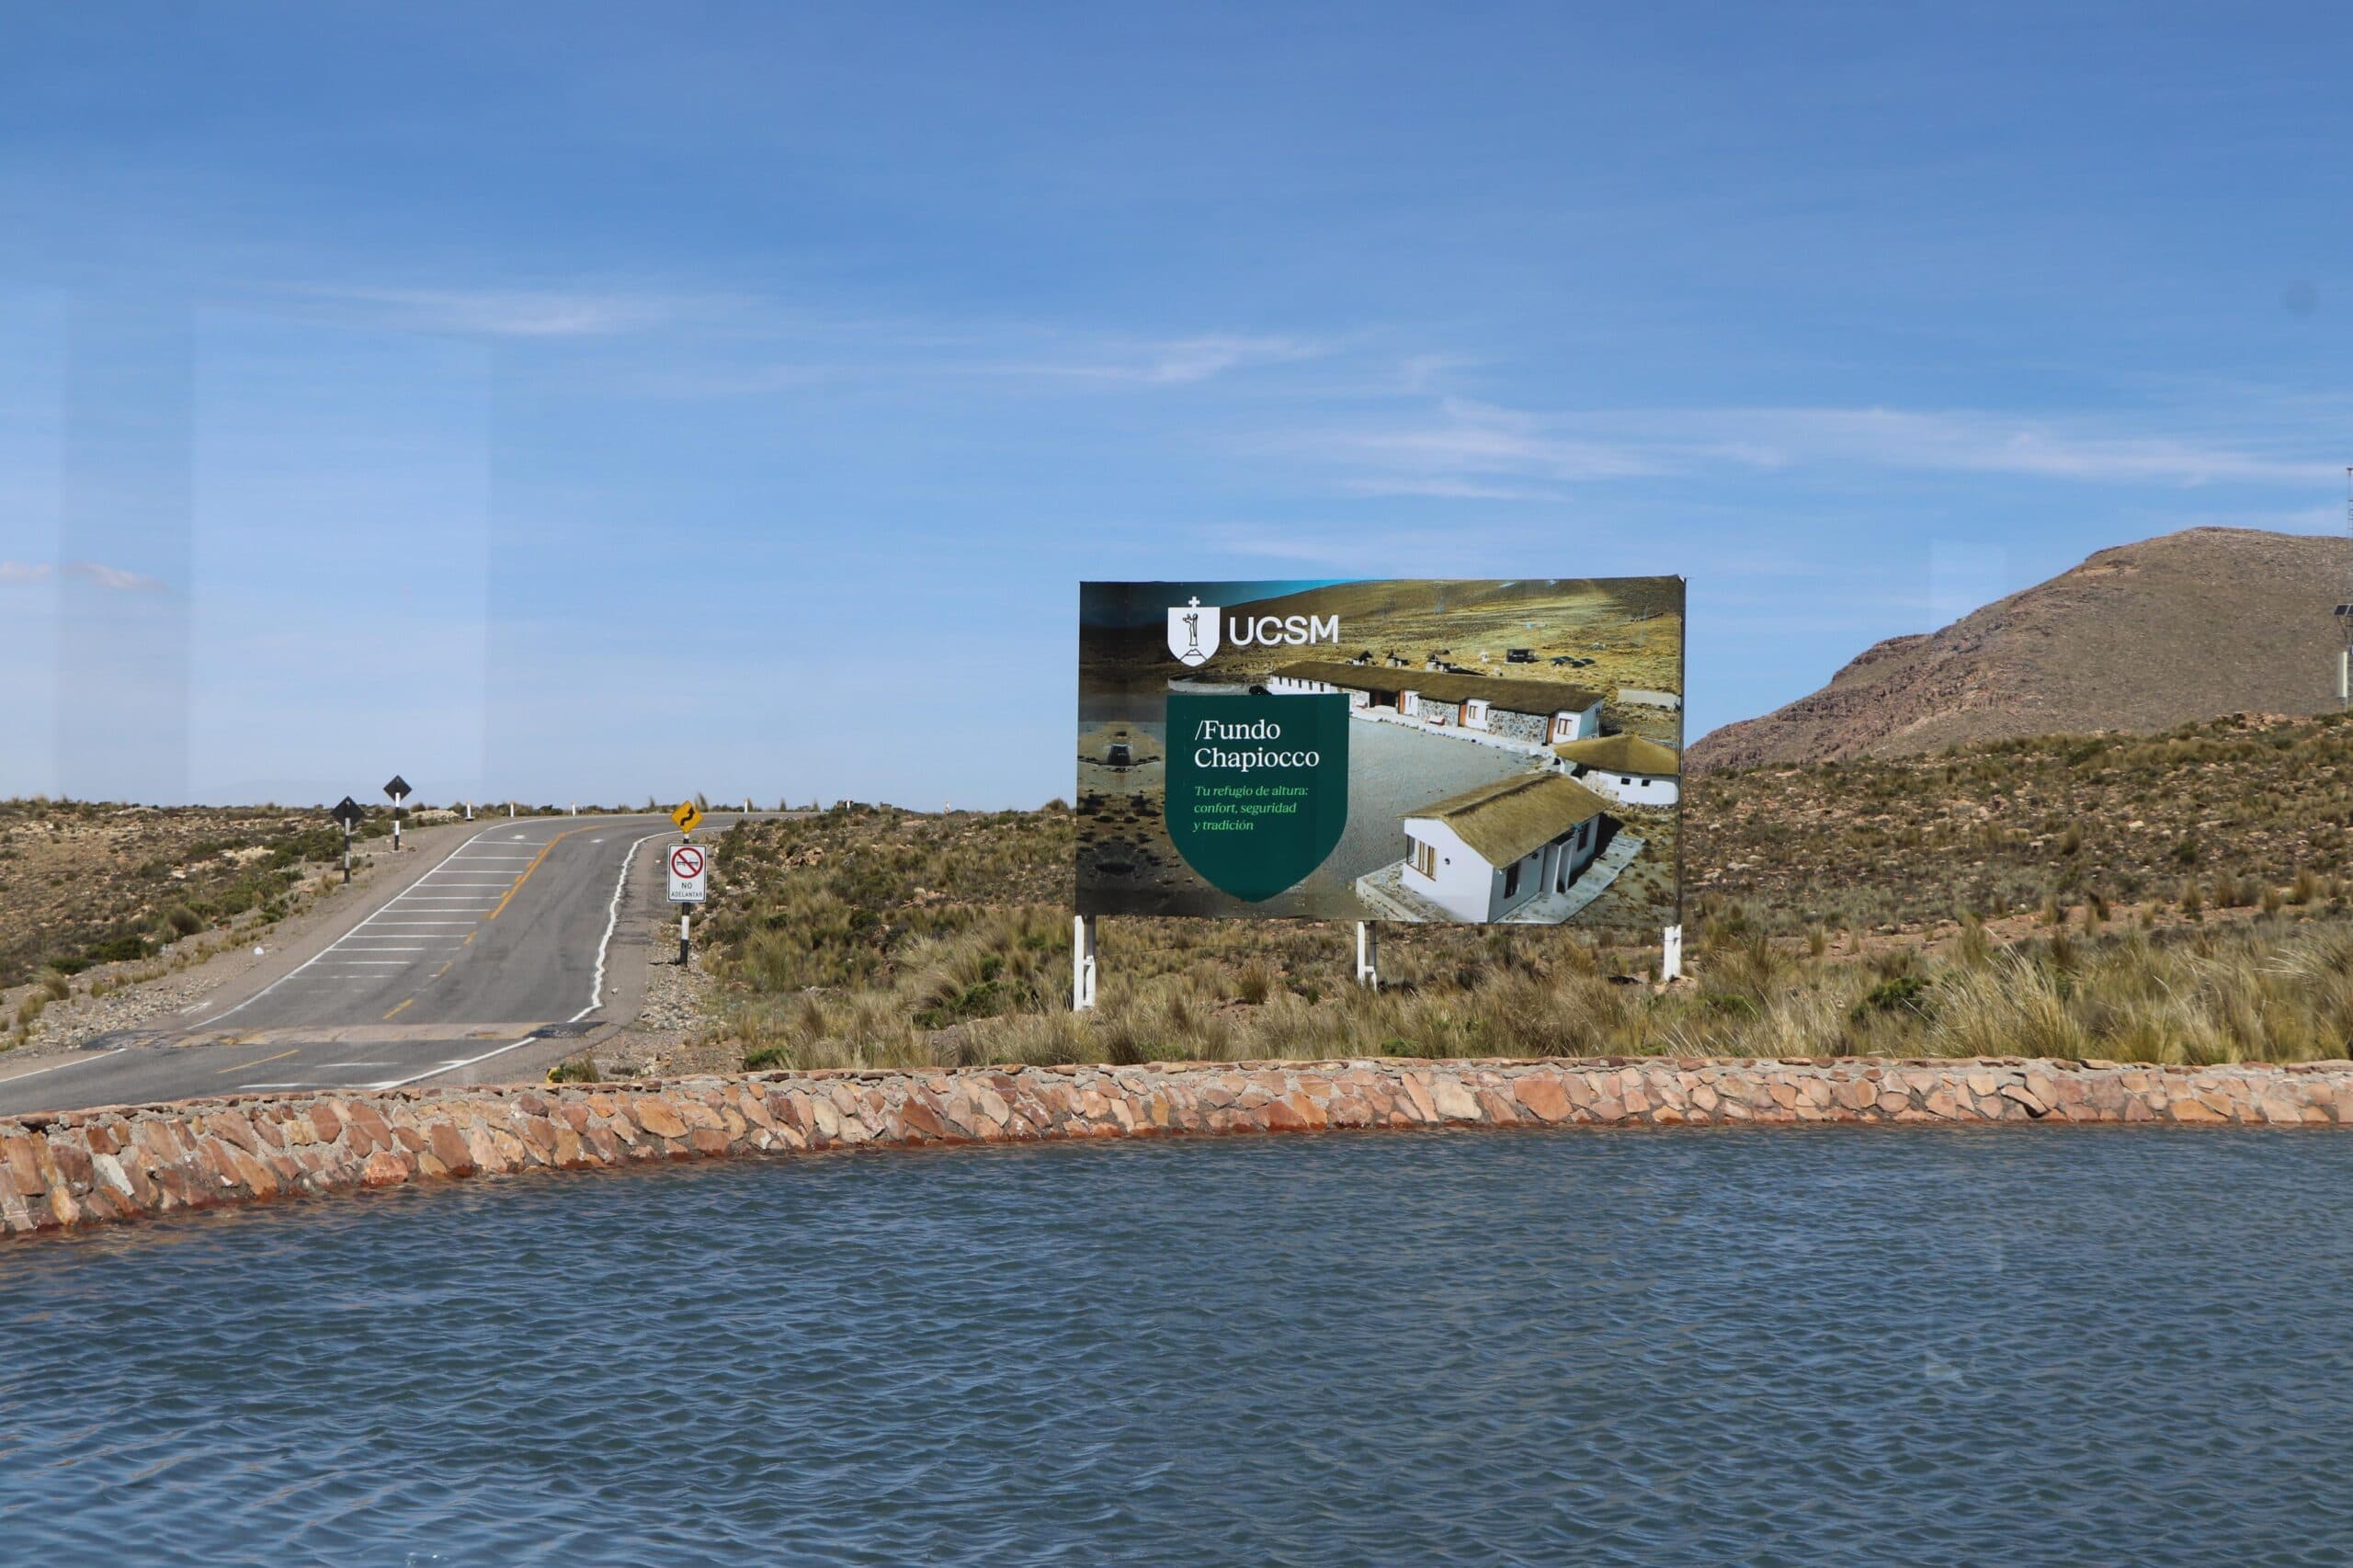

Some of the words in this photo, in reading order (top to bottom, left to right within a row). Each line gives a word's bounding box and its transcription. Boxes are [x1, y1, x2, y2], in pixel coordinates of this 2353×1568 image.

[1229, 615, 1339, 646] UCSM
[1194, 747, 1320, 772] Chapiocco
[1195, 786, 1211, 797] Tu
[1212, 785, 1253, 799] refugio
[1255, 786, 1270, 797] de
[1271, 785, 1309, 796] altura:
[1194, 802, 1238, 815] confort,
[1240, 802, 1297, 816] seguridad
[1192, 822, 1200, 833] y
[1202, 819, 1254, 831] tradición
